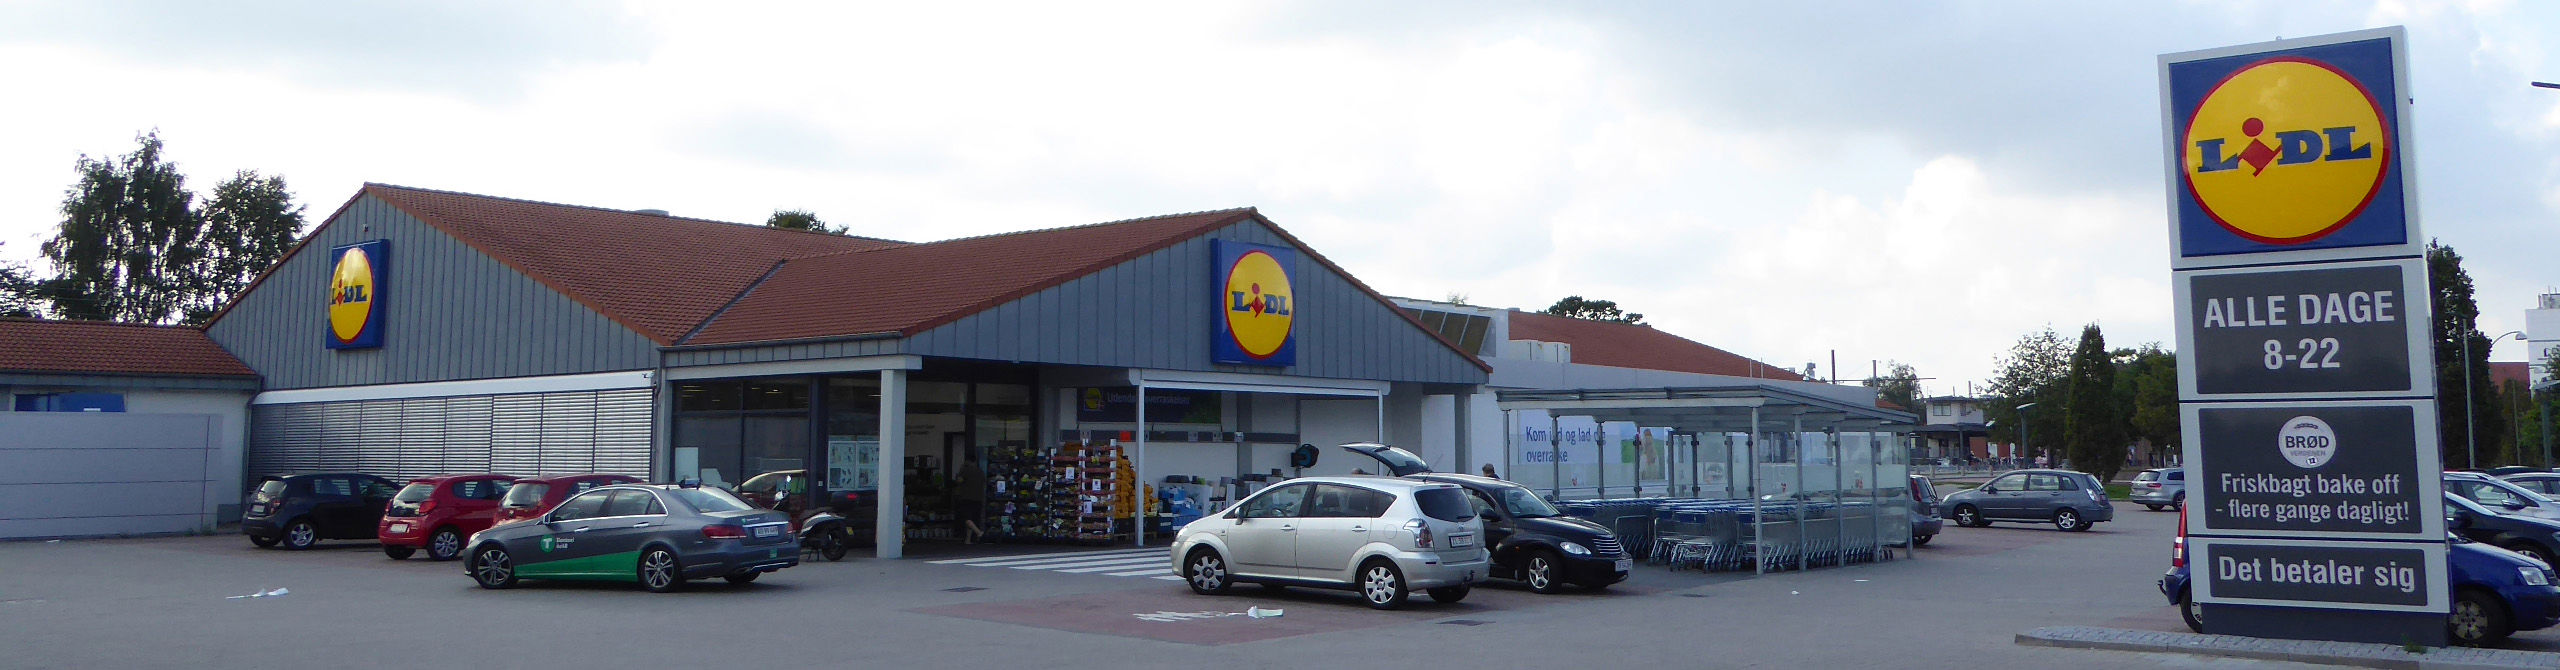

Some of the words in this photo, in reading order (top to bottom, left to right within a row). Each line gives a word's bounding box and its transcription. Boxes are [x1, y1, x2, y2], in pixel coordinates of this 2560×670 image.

[2203, 295, 2287, 328] ALLE
[2298, 290, 2395, 325] DAGE
[2263, 337, 2341, 370] 8-22
[1526, 426, 1547, 442] Kom
[1549, 426, 1563, 442] id
[1565, 430, 1577, 446] og
[1578, 427, 1591, 442] lad
[1593, 427, 1607, 446] dg
[2285, 435, 2330, 449] BRØD
[1526, 444, 1568, 463] overrake
[2221, 473, 2312, 498] Friskbagt
[2317, 473, 2366, 494] bake
[2372, 474, 2400, 495] off
[2228, 499, 2270, 518] flere
[2275, 502, 2331, 523] gange
[2337, 501, 2409, 525] dagligt!
[2218, 556, 2263, 582] Det
[2270, 557, 2365, 585] betaler
[2374, 561, 2416, 593] sig
